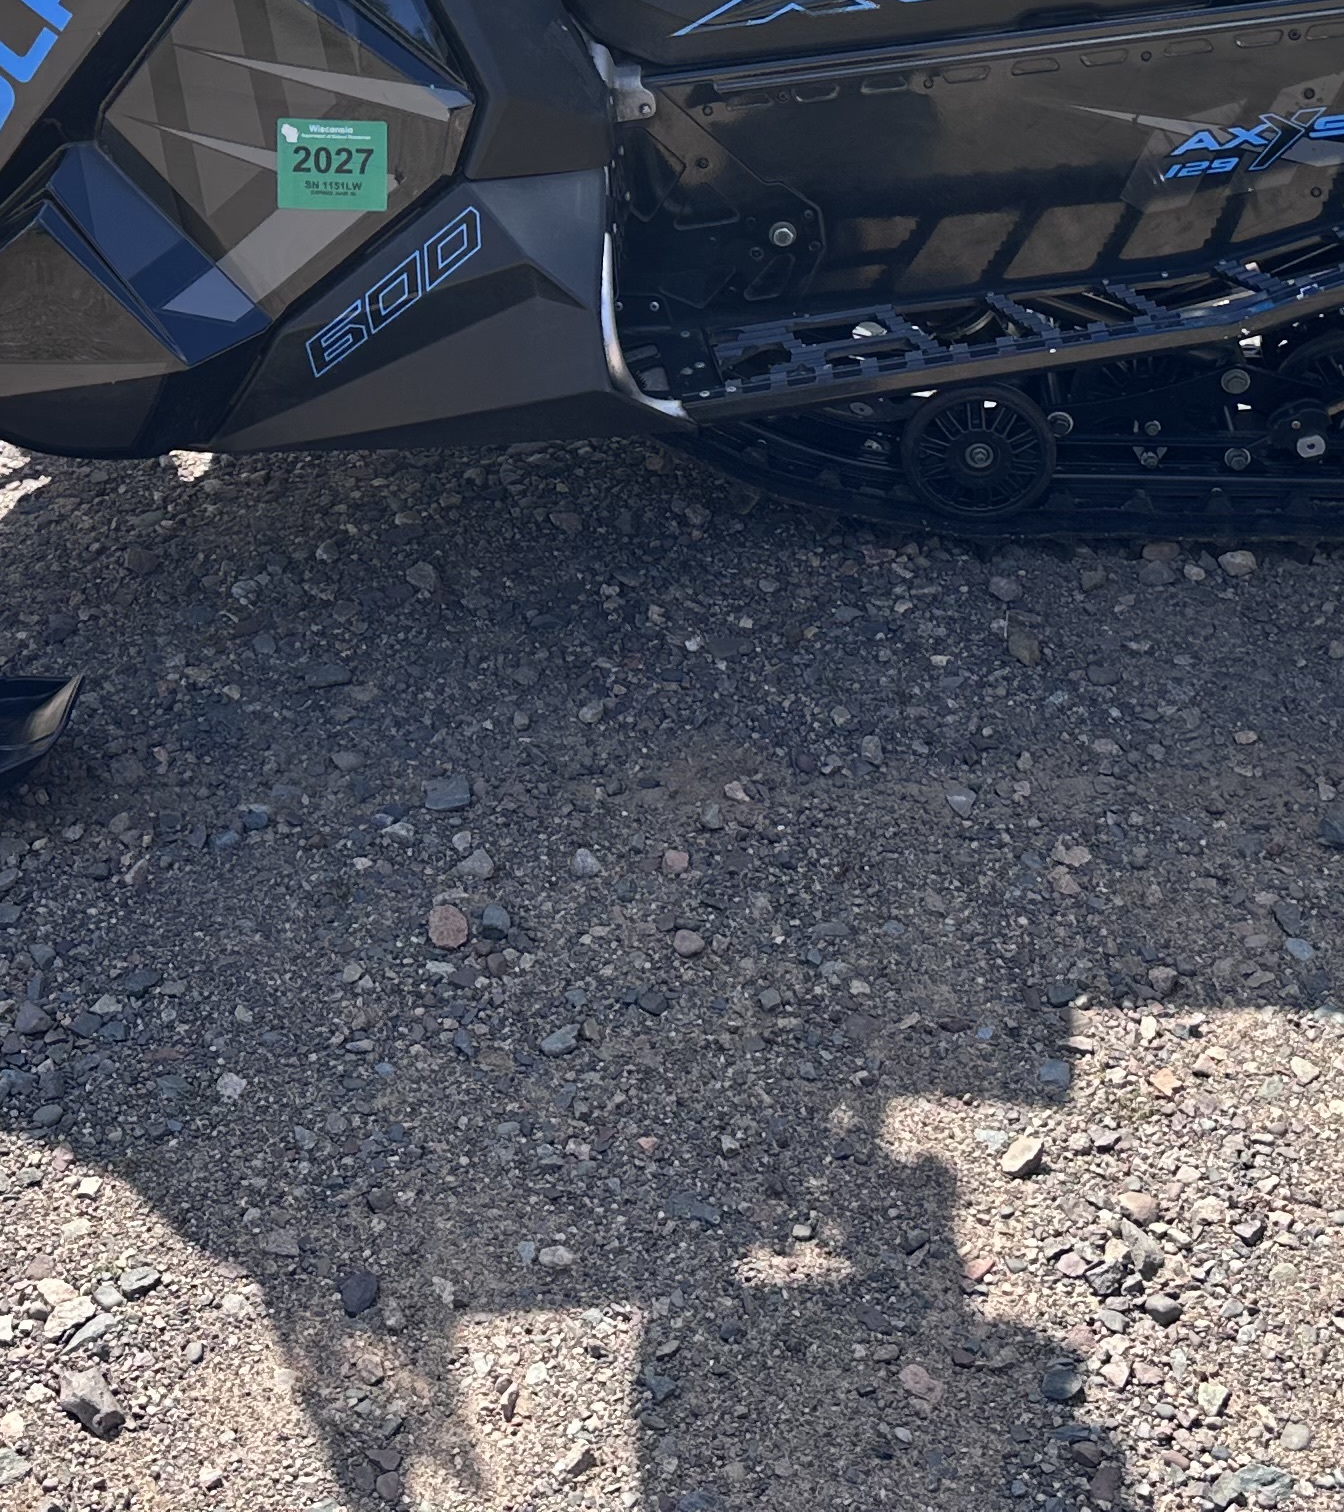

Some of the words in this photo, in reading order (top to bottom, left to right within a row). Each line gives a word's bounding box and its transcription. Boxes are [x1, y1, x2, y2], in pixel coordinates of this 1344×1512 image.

[308, 124, 354, 134] Wisconsin
[292, 145, 375, 175] 2027
[1163, 156, 1210, 179] 129
[305, 205, 482, 378] 600
